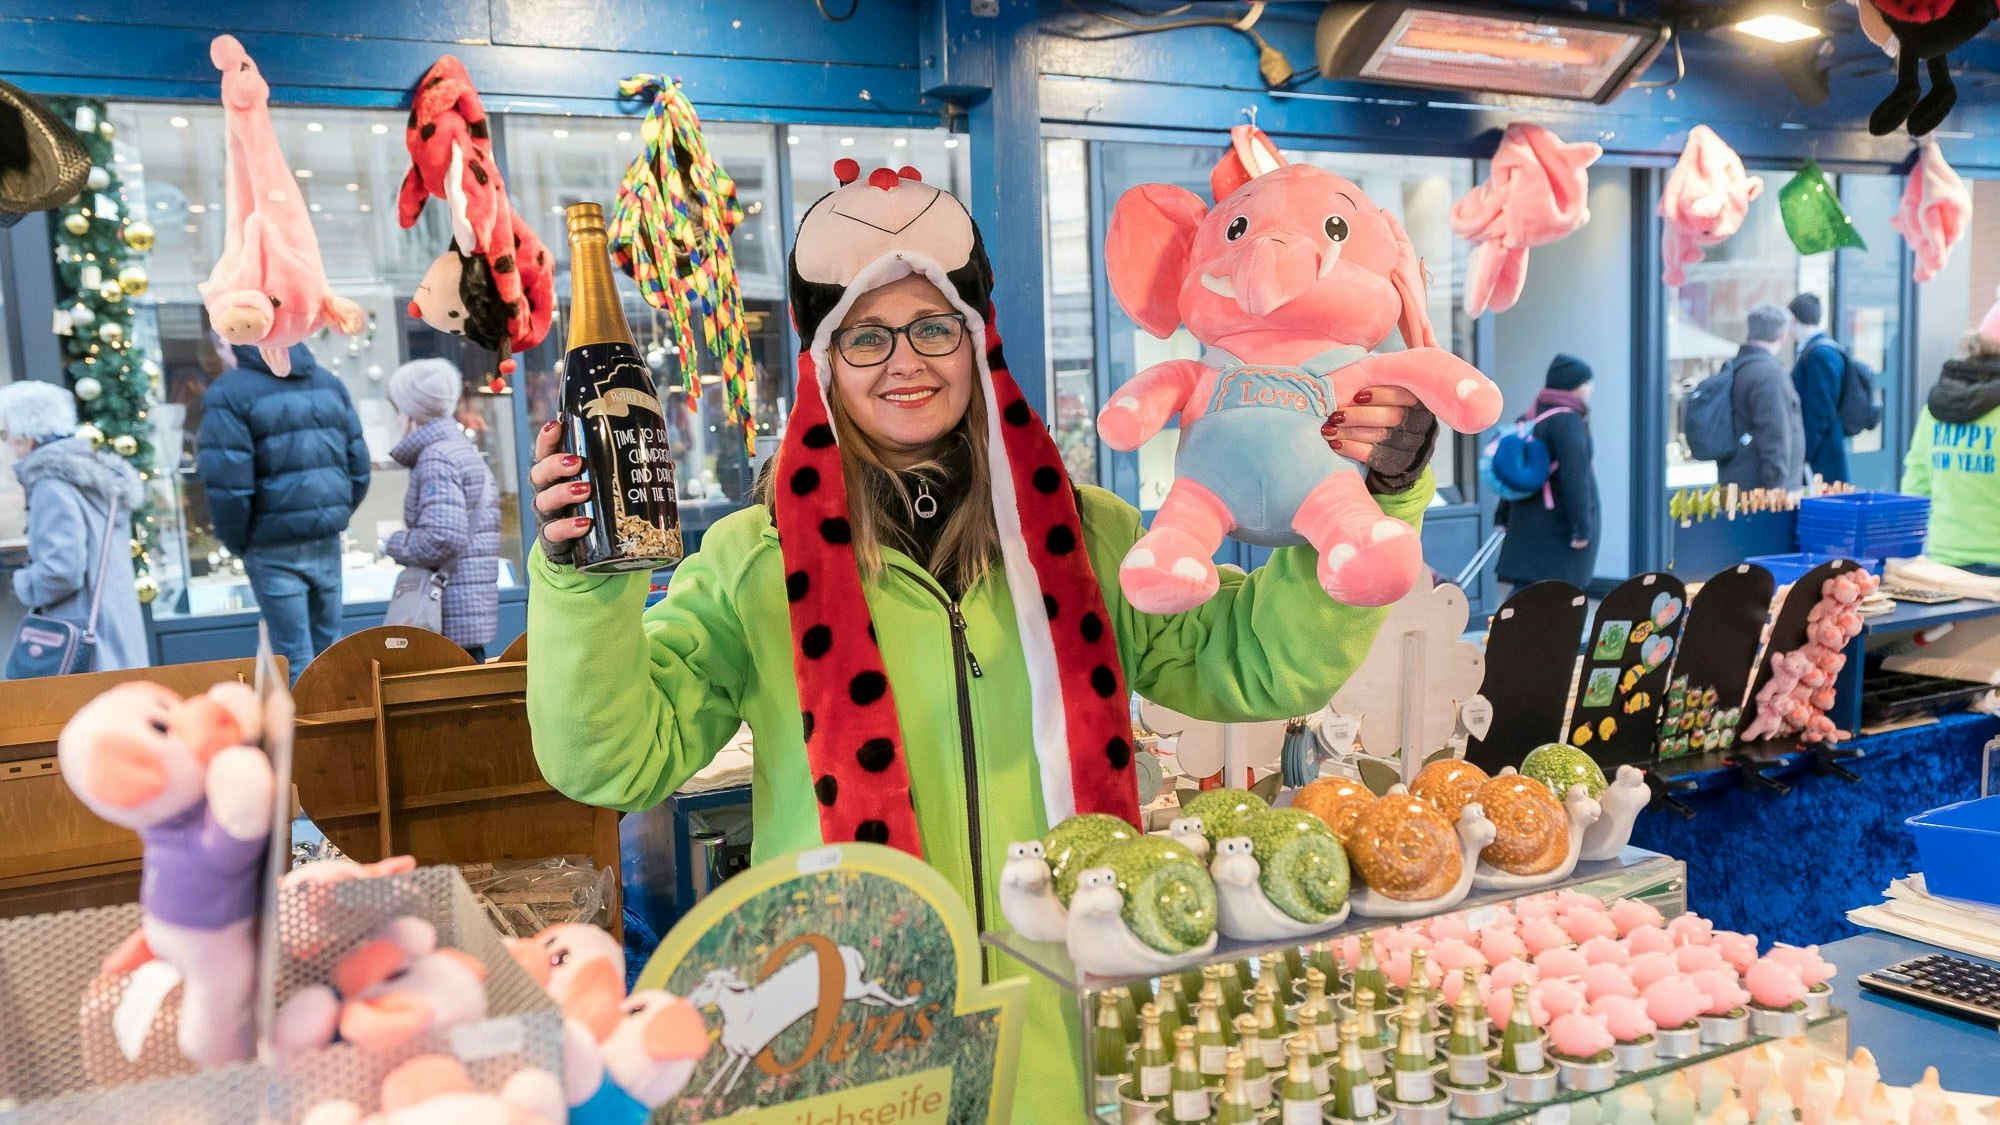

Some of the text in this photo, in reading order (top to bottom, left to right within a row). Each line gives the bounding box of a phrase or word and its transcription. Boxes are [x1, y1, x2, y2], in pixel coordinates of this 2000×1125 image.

[1240, 381, 1308, 411] Love
[613, 429, 637, 449] TIME
[640, 428, 653, 443] TO
[1933, 421, 1997, 450] HAPPY
[1958, 453, 1995, 473] YEAR
[631, 468, 653, 484] AND
[627, 487, 648, 504] ON
[651, 487, 665, 502] THE
